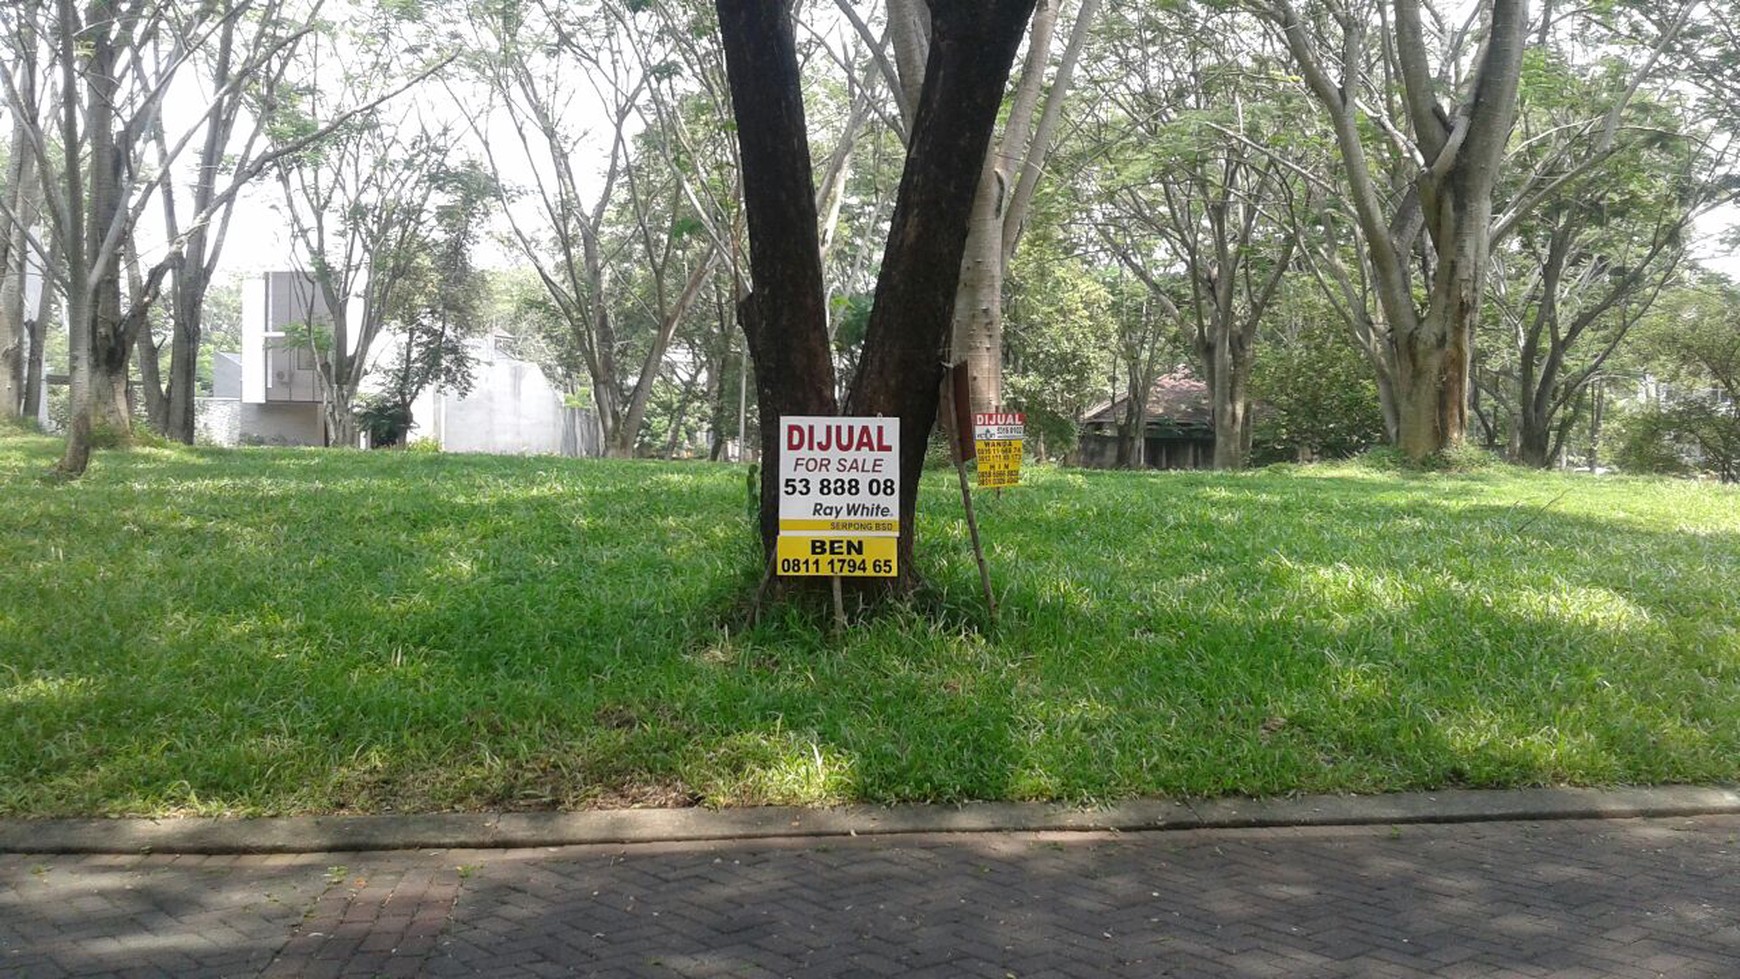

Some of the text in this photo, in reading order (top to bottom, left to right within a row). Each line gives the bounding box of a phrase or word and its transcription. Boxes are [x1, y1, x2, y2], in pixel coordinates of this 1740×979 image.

[976, 414, 1022, 425] DIJUAL
[787, 424, 893, 452] DIJUAL
[793, 458, 884, 473] FOR SALE
[784, 478, 811, 496] 53
[868, 478, 896, 496] 08
[812, 502, 844, 519] Ray
[830, 521, 893, 531] SERPONG BSD
[810, 540, 864, 555] BEN
[781, 558, 893, 574] 0811 1794 65
